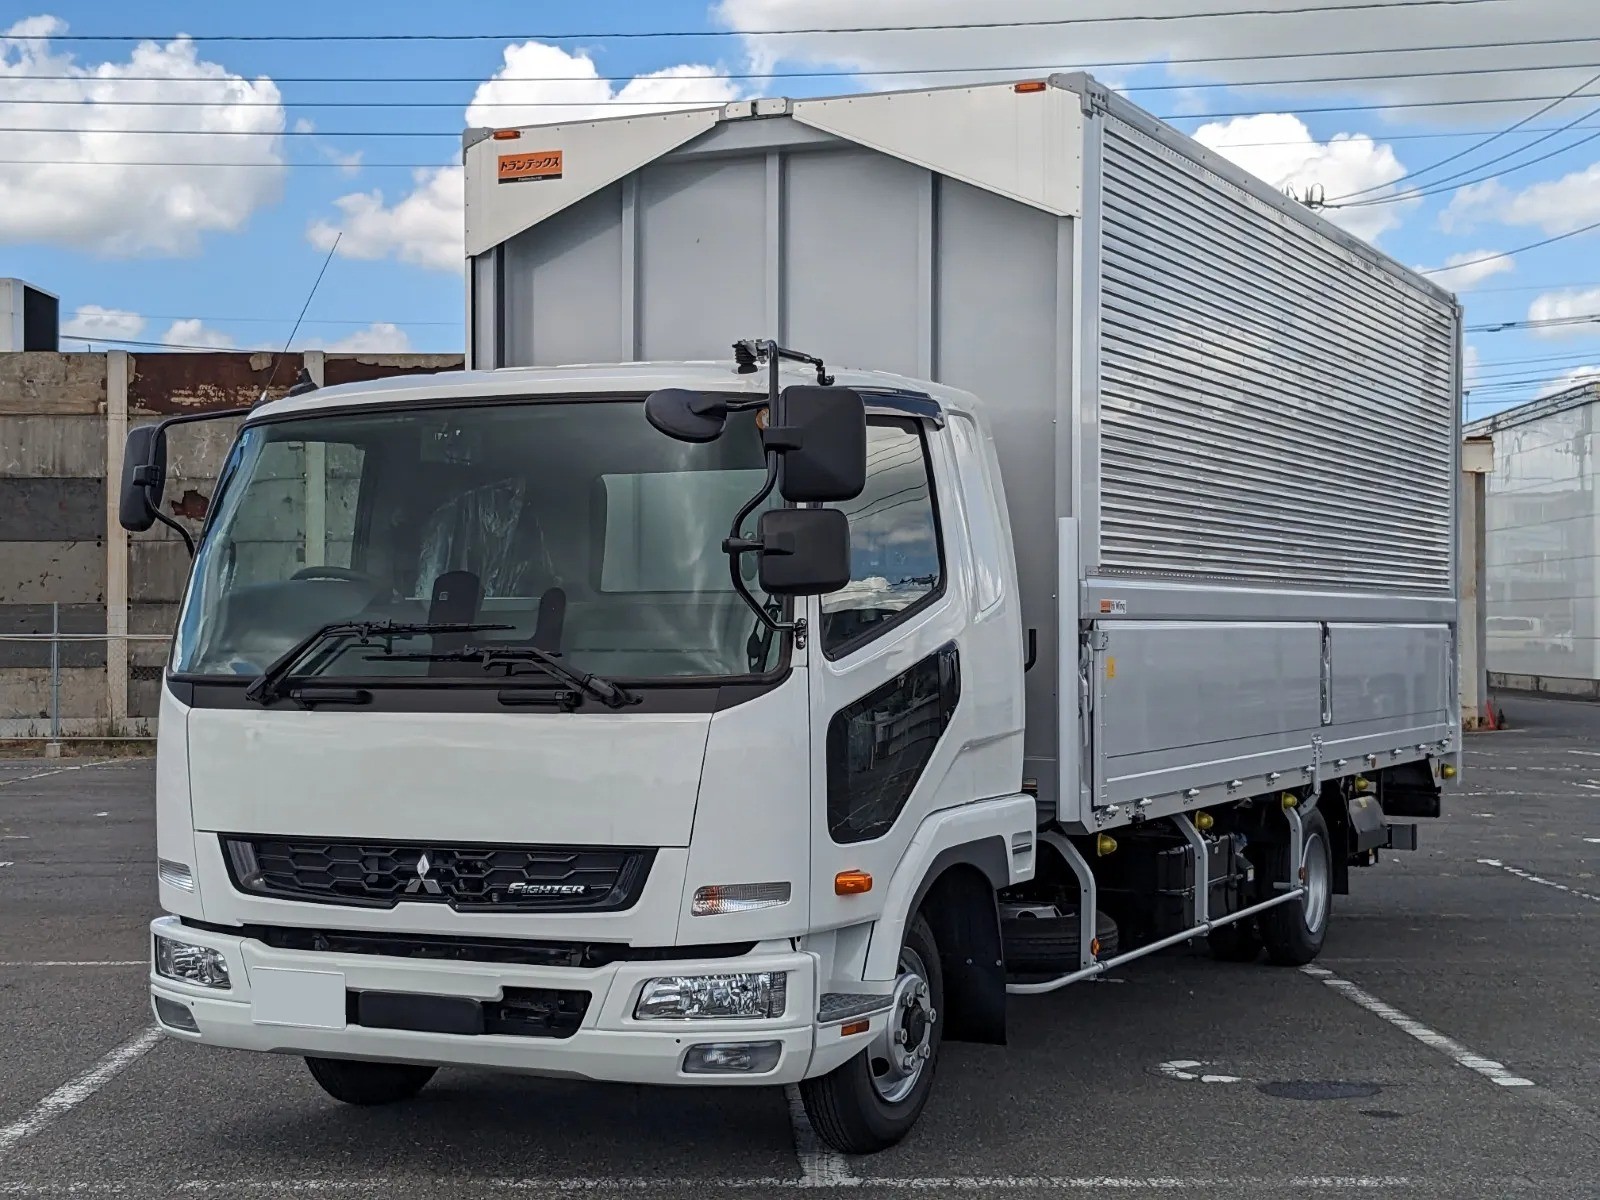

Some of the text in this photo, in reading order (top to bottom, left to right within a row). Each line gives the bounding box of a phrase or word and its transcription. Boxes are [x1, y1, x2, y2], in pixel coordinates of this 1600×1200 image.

[501, 156, 560, 171] トランテックス
[507, 882, 585, 894] FIGHTER
